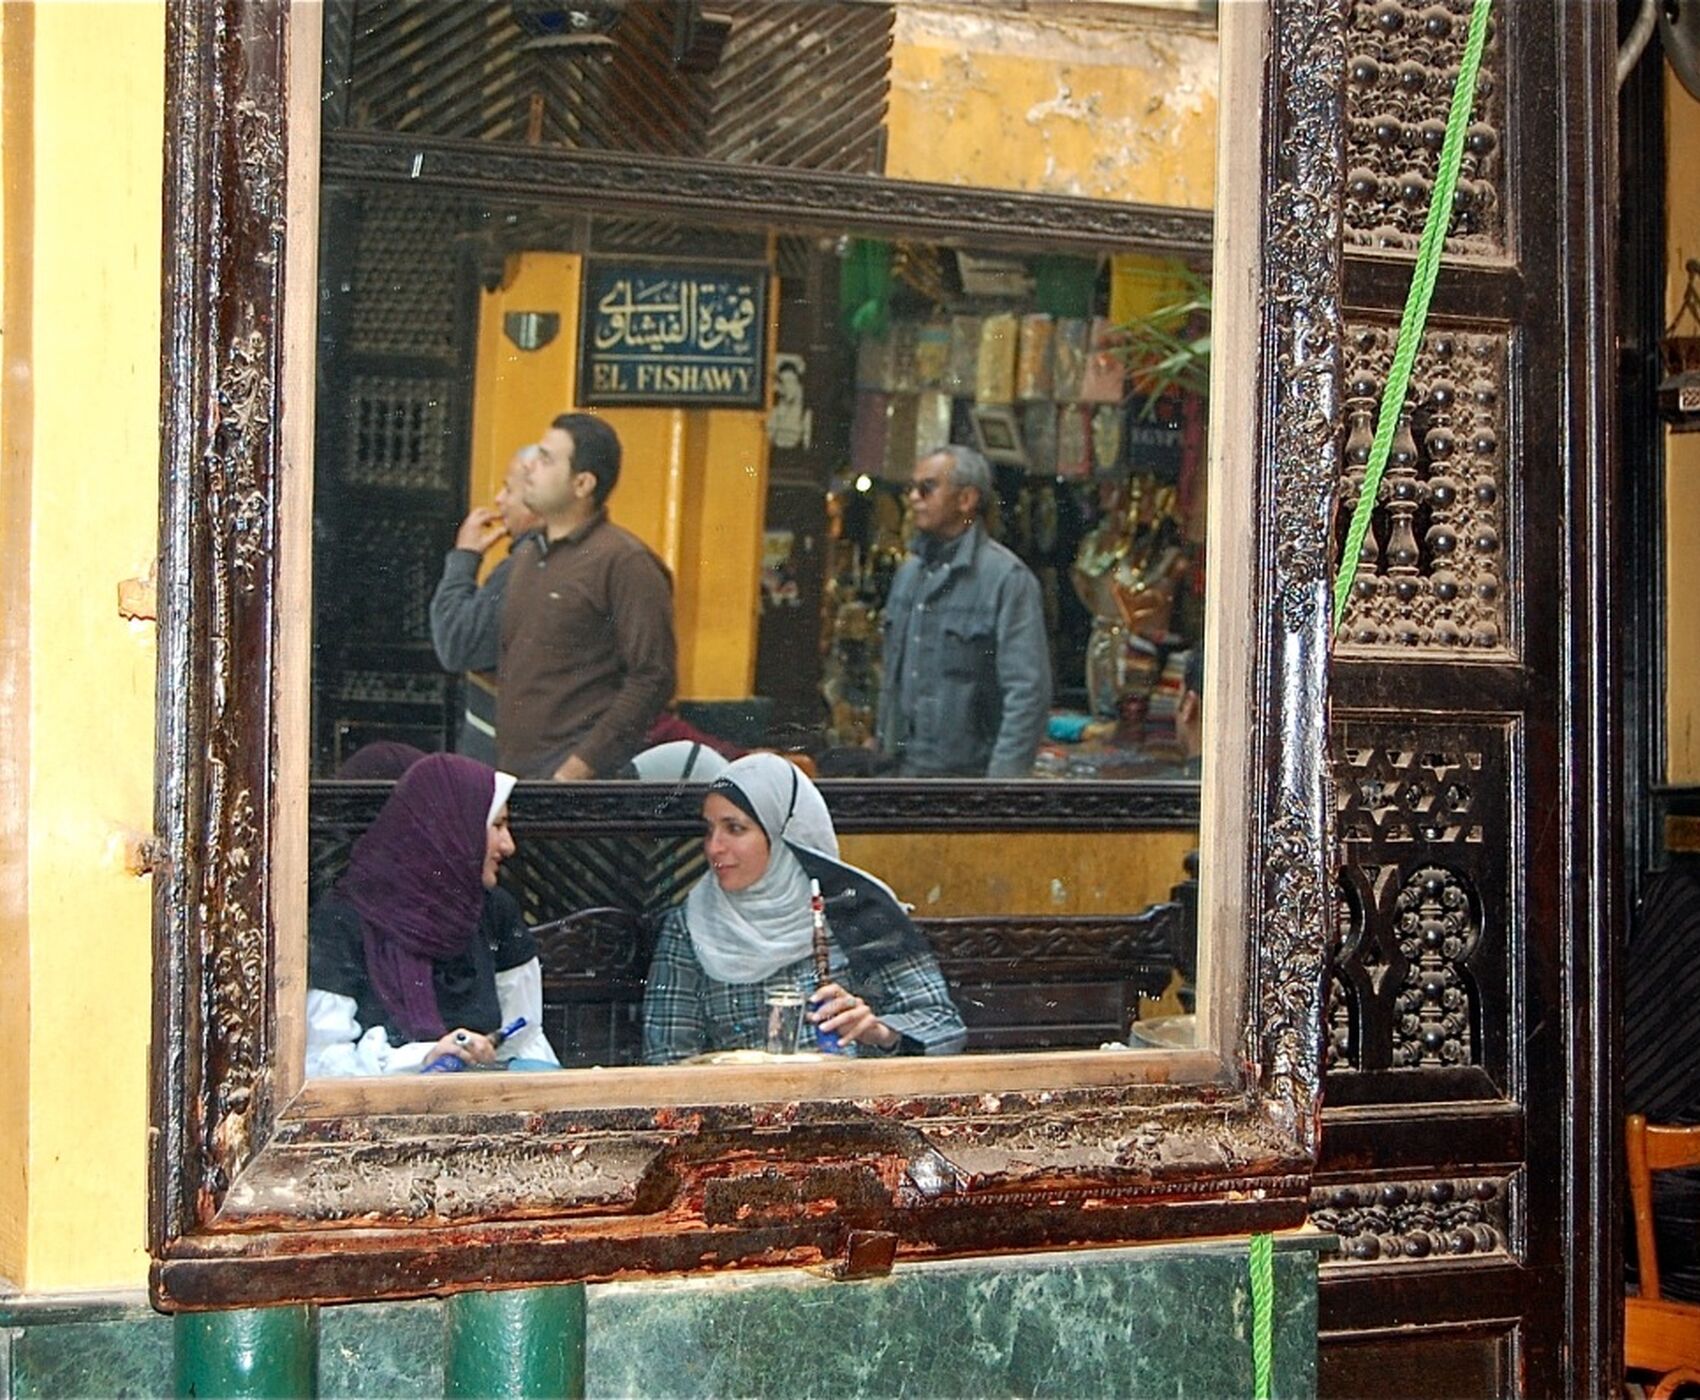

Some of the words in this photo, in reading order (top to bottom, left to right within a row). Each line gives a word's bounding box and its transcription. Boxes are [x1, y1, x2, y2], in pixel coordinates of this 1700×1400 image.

[698, 284, 755, 352] قهوة
[593, 363, 627, 391] EL
[637, 365, 751, 391] FISHAWY
